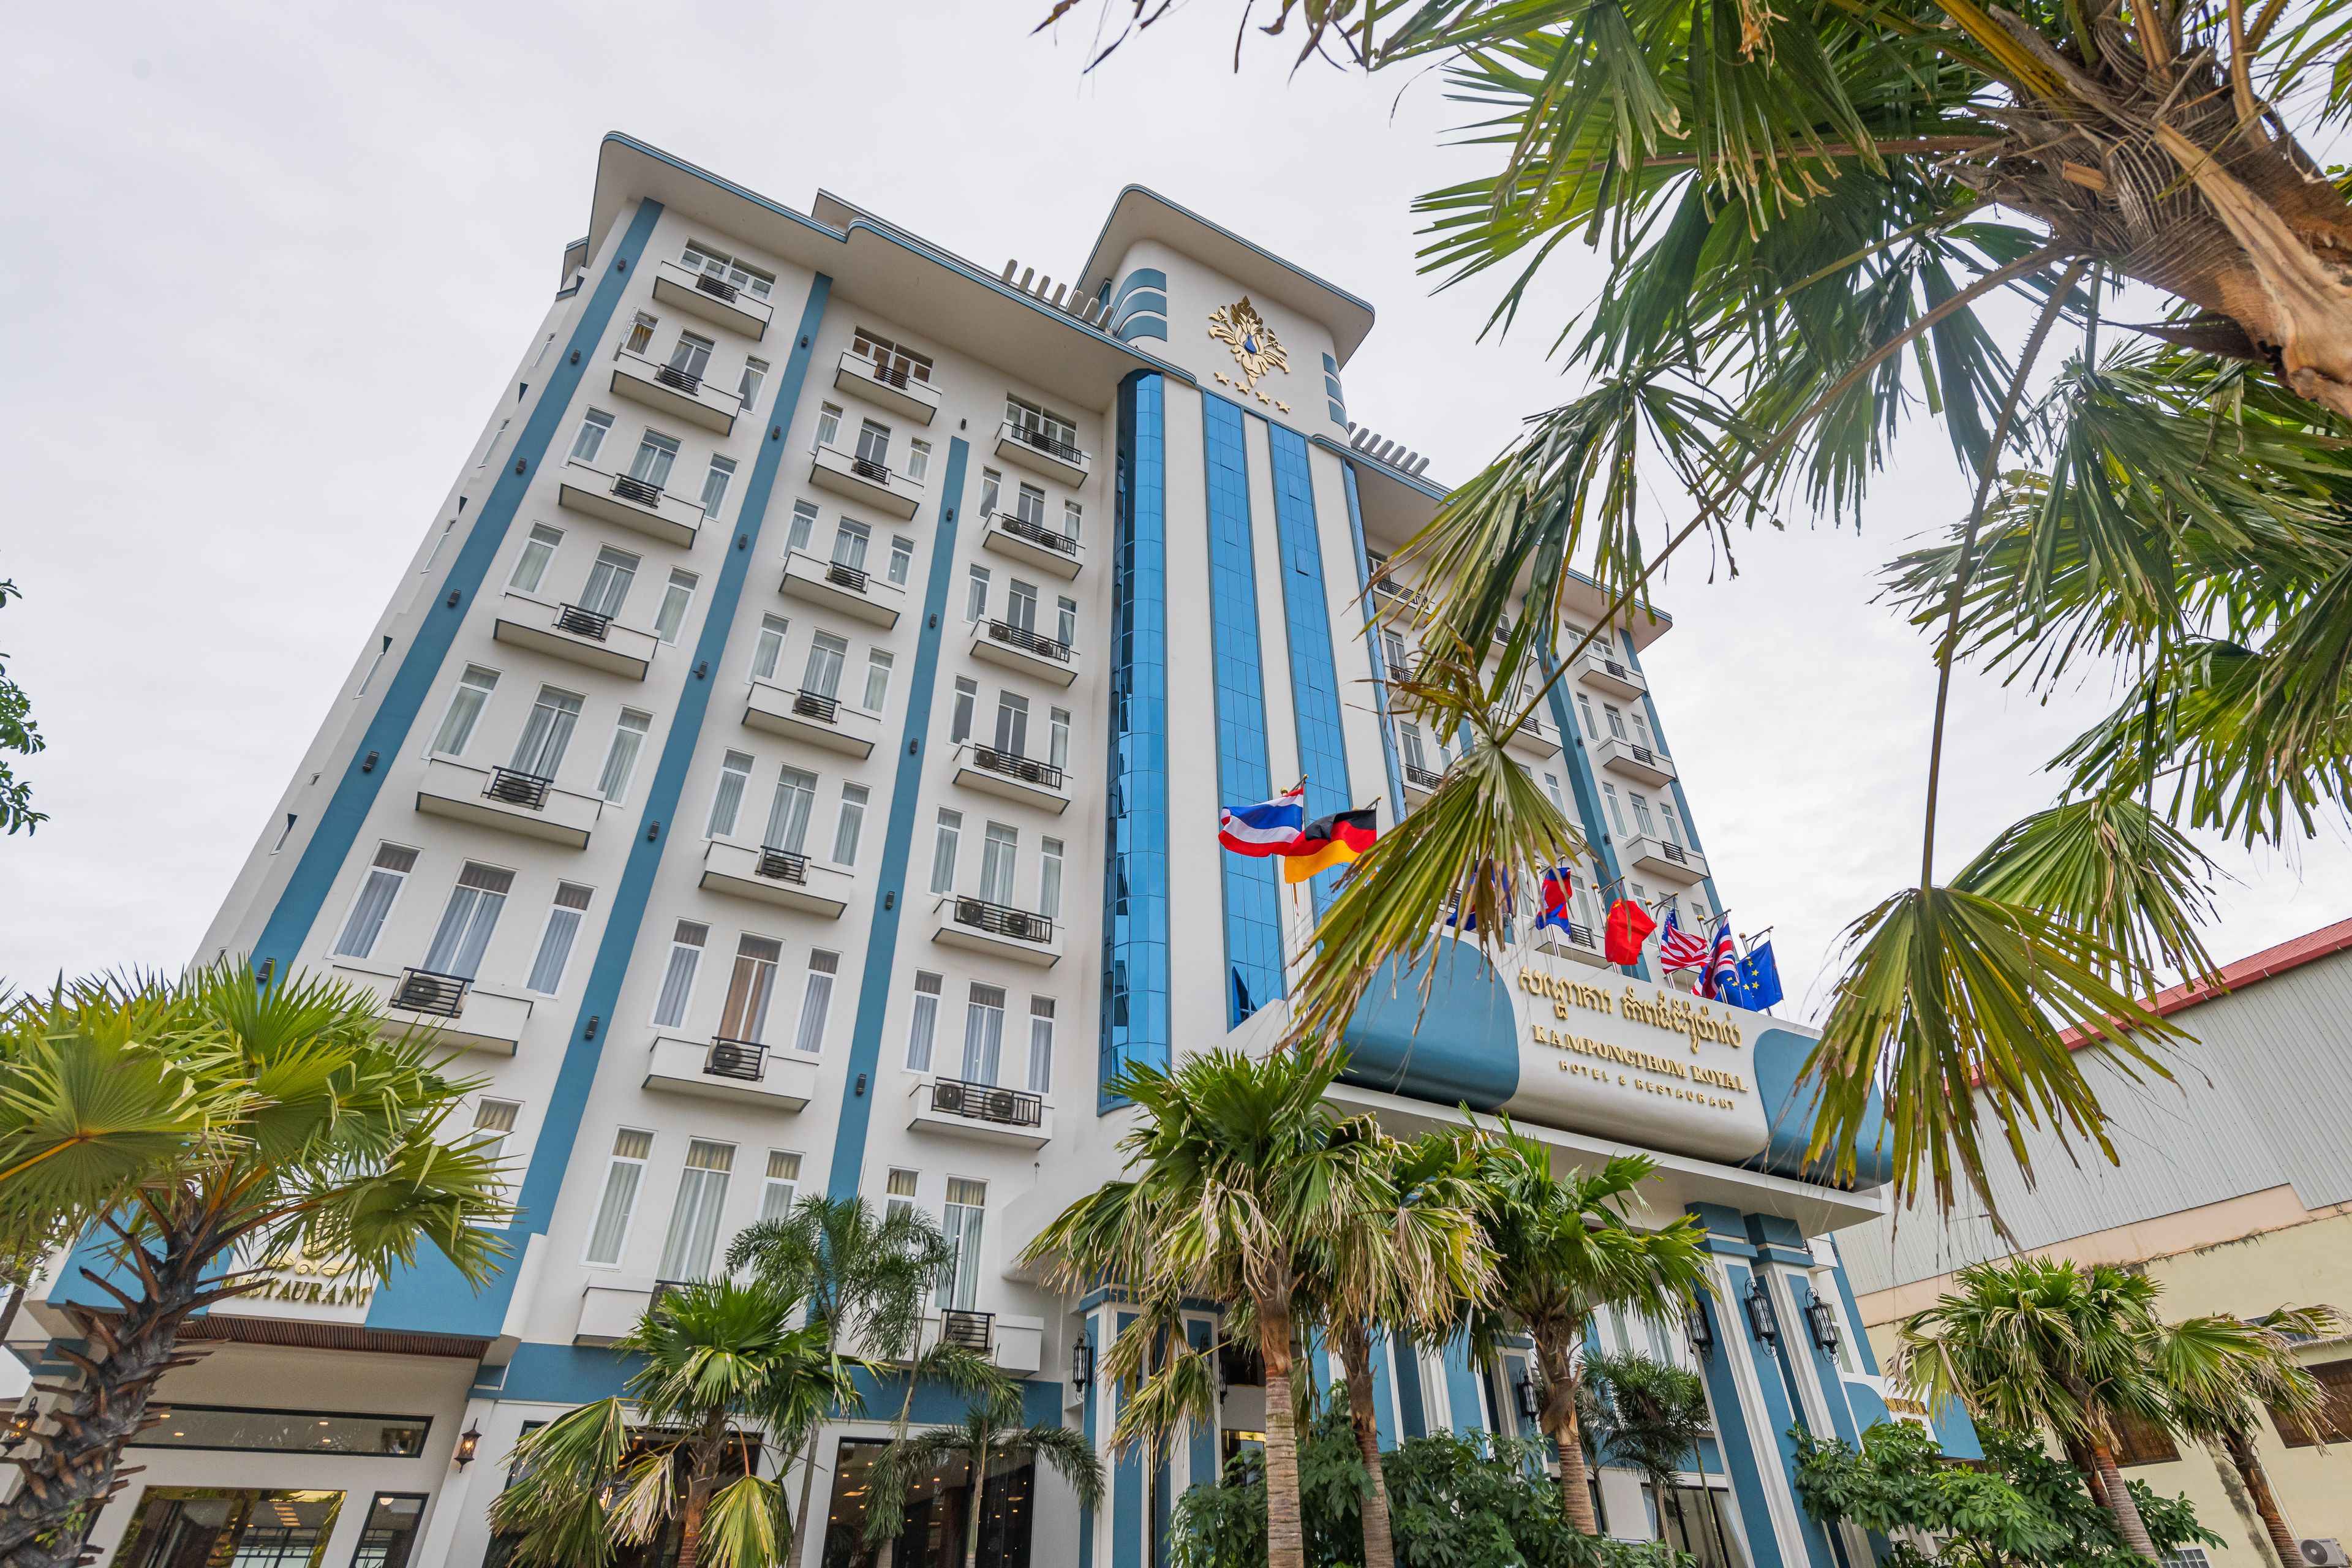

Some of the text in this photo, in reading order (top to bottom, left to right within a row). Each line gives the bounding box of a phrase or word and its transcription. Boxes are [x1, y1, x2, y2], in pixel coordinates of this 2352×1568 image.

[1532, 1024, 1750, 1092] KAMPONGTHOM ROYAL
[1559, 1060, 1735, 1110] HOTEL & RESTAURANT
